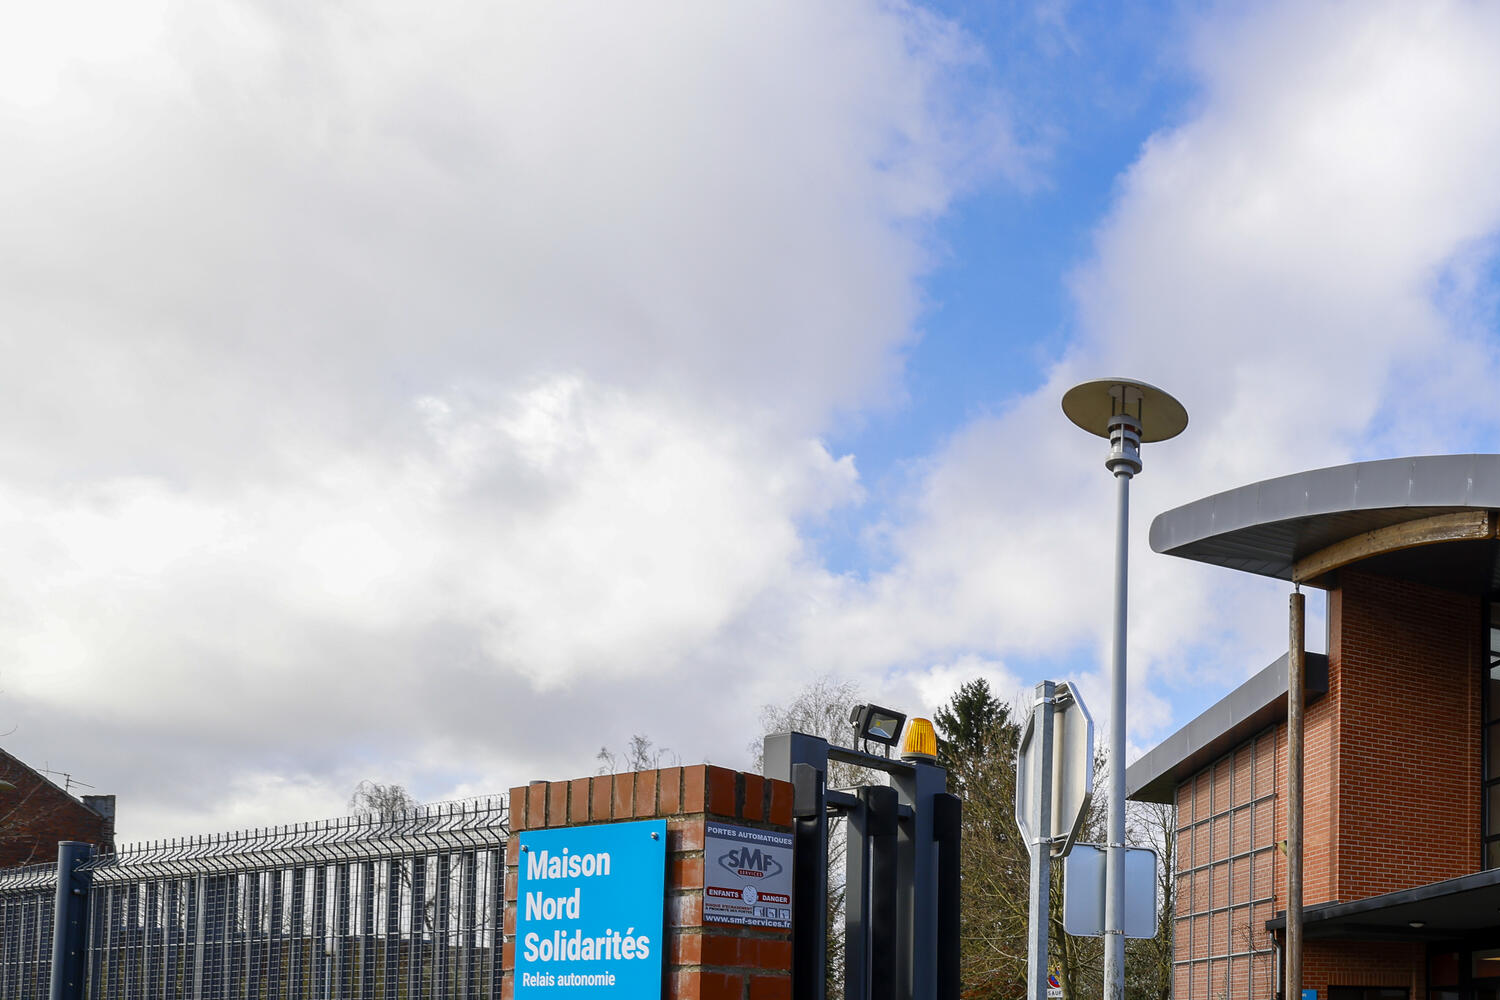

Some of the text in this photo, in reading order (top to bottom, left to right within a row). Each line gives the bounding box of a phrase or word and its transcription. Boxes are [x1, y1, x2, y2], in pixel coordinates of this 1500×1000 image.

[707, 826, 793, 845] PORTES AUTOMATIQUES
[527, 847, 611, 880] Maison
[728, 846, 773, 871] SMF
[709, 889, 739, 898] ENFANTS
[762, 895, 788, 903] DANGER
[525, 887, 581, 921] Nord
[705, 915, 791, 928] www.smf-services.fr
[523, 927, 650, 962] Solidarités
[522, 971, 616, 987] Relais autonomie
